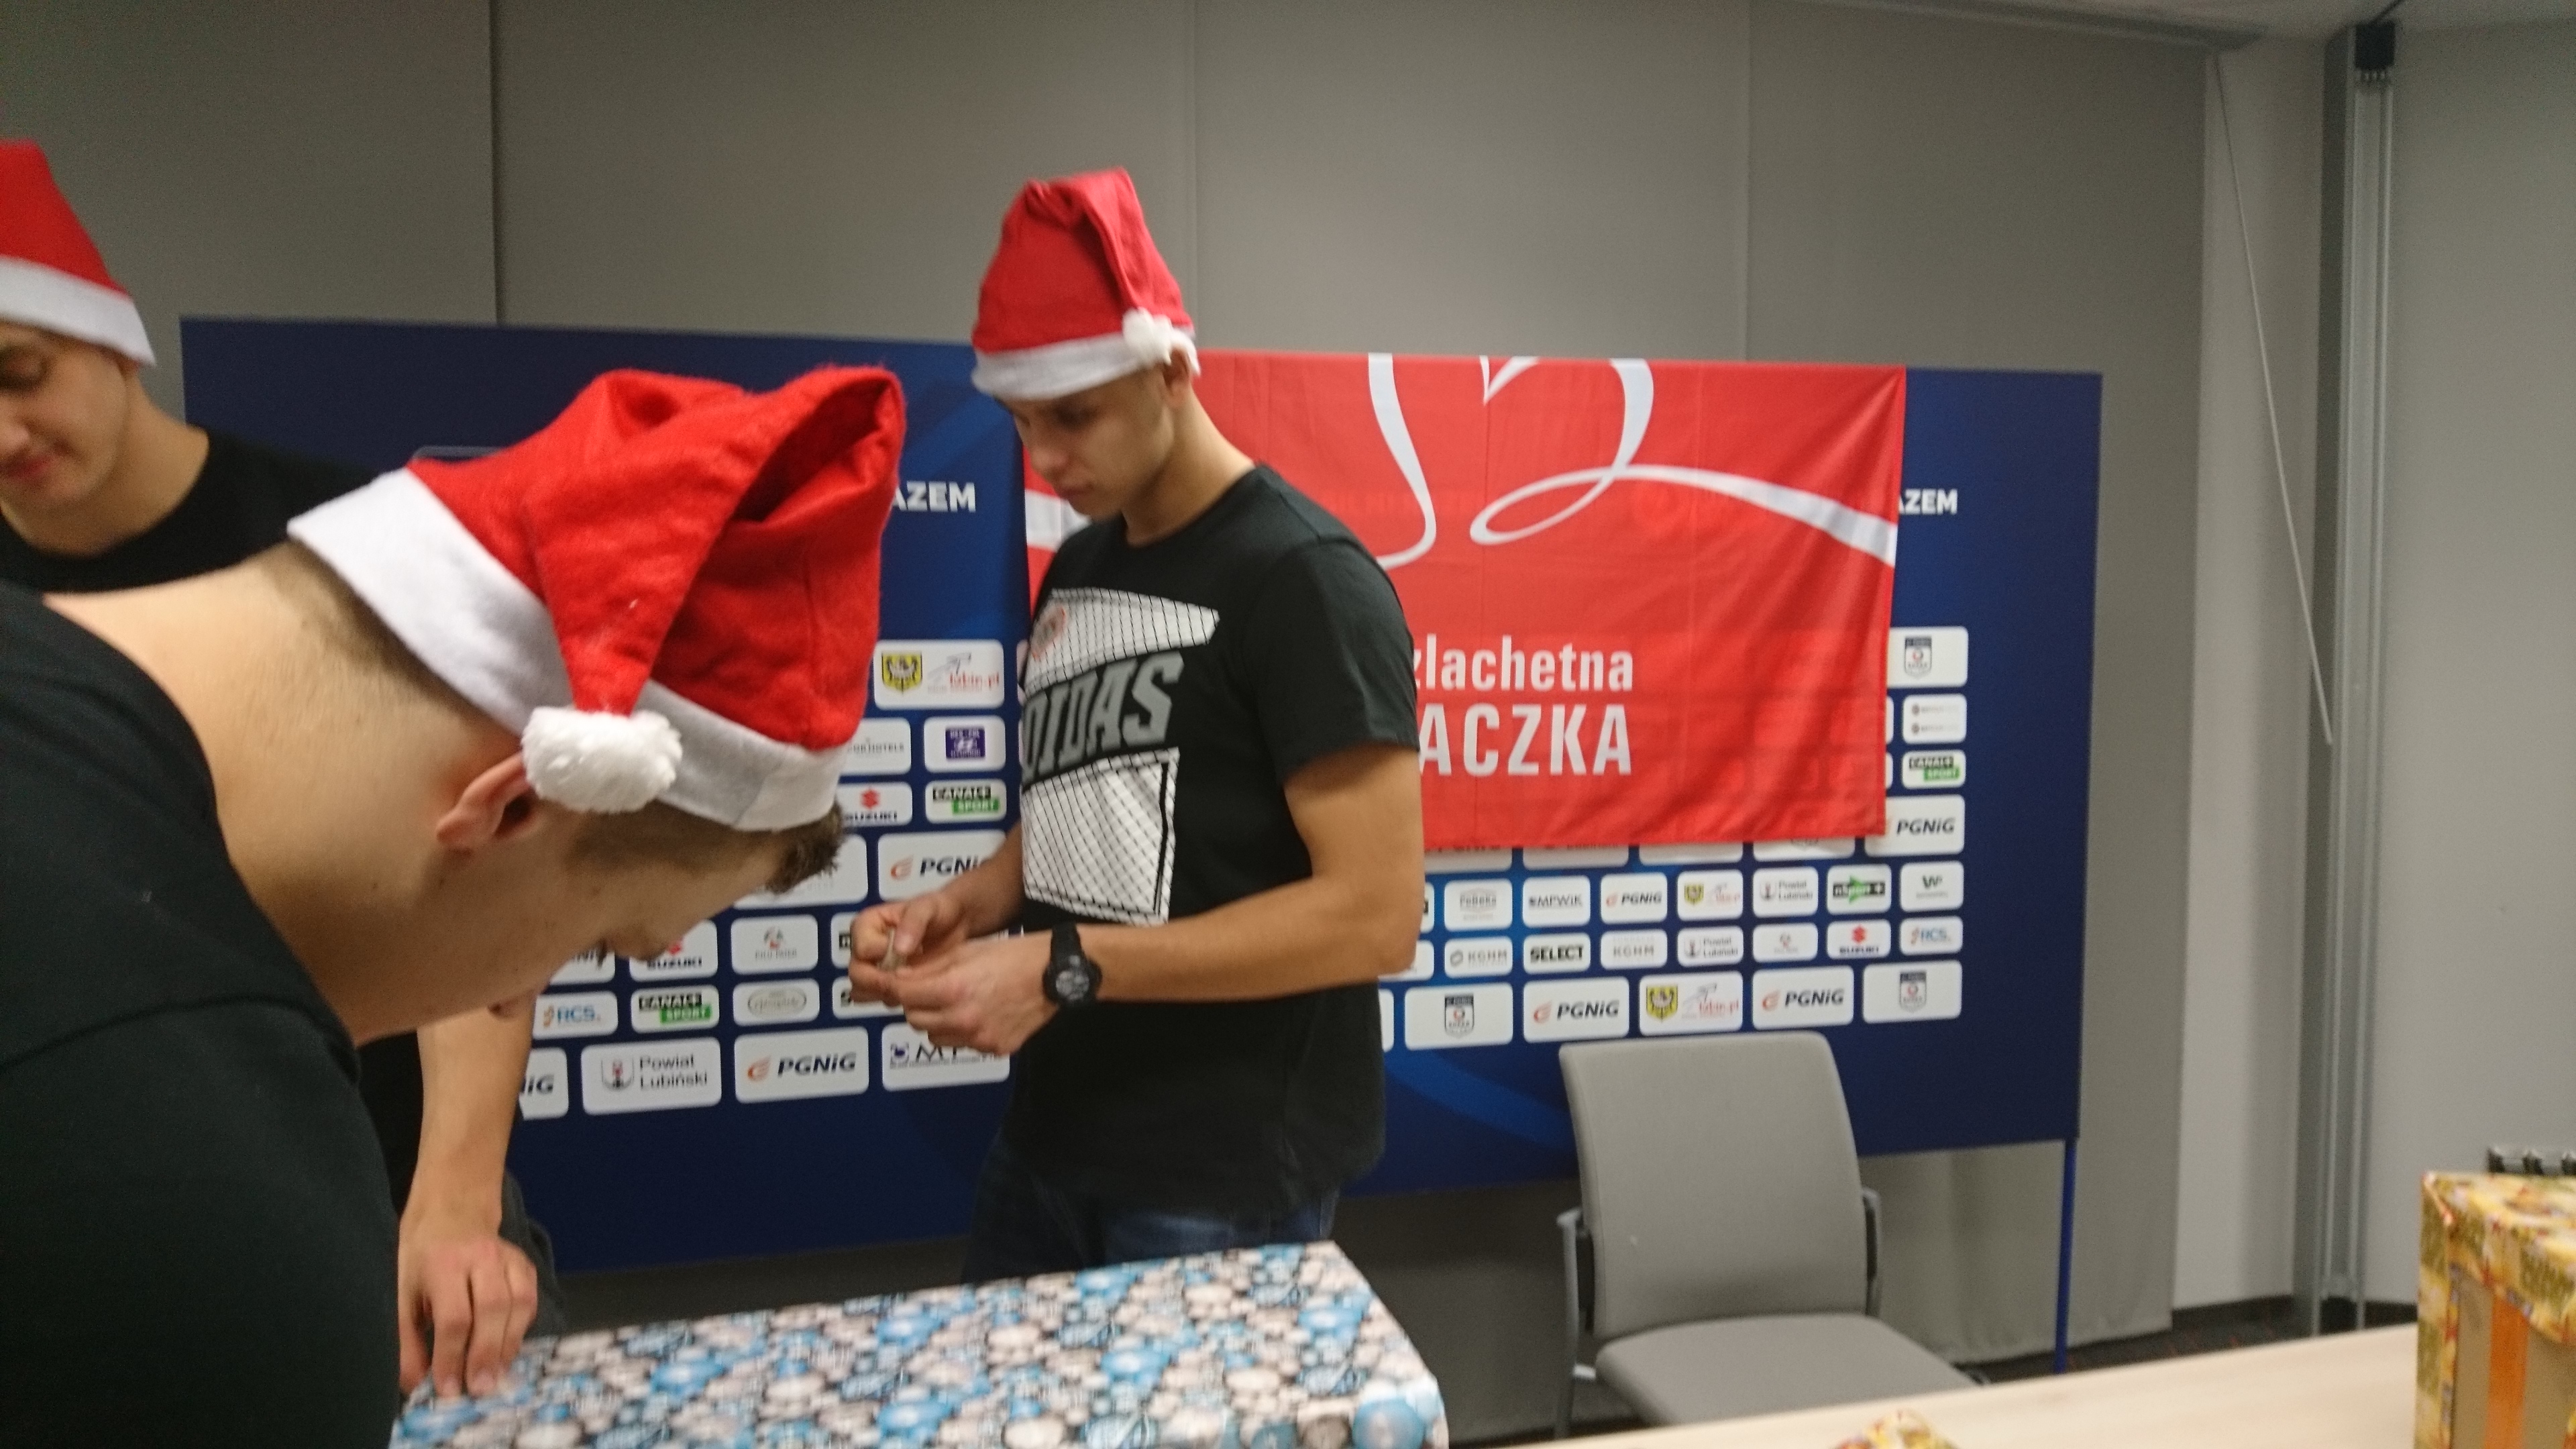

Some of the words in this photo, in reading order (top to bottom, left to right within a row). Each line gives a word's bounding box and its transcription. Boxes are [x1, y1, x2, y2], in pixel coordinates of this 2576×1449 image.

[1419, 702, 1631, 777] ACZKA
[1896, 818, 1955, 836] PGNiG
[1530, 945, 1584, 963] SELECT
[1785, 988, 1845, 1008] PGNiG
[1557, 1000, 1620, 1021] PGNiG
[639, 1053, 694, 1071] Powiat
[777, 1051, 857, 1078] PGNiG
